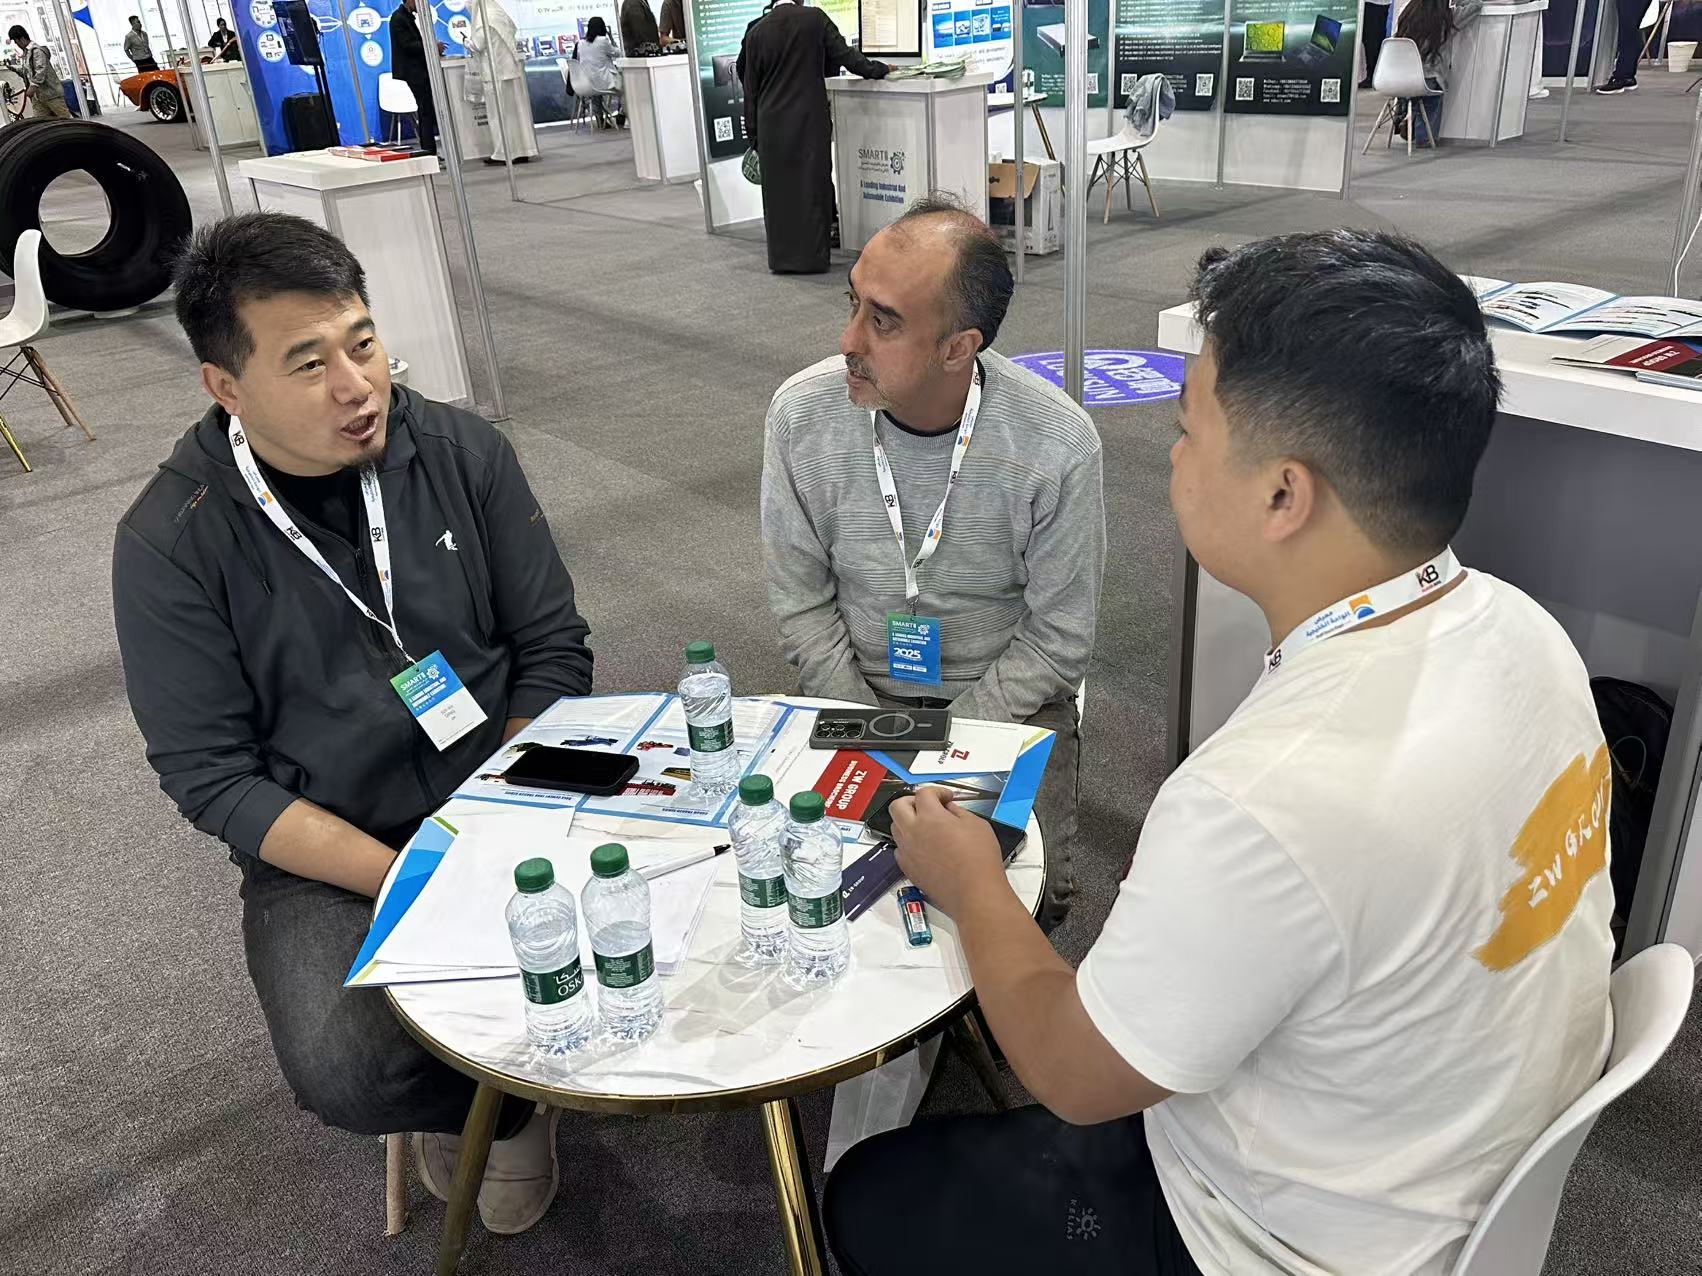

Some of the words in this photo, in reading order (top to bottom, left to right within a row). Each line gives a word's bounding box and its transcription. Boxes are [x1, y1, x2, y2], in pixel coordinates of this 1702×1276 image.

[1416, 564, 1440, 588] KB
[893, 647, 921, 659] 2025
[851, 770, 868, 784] ZW
[836, 783, 859, 810] GROUP
